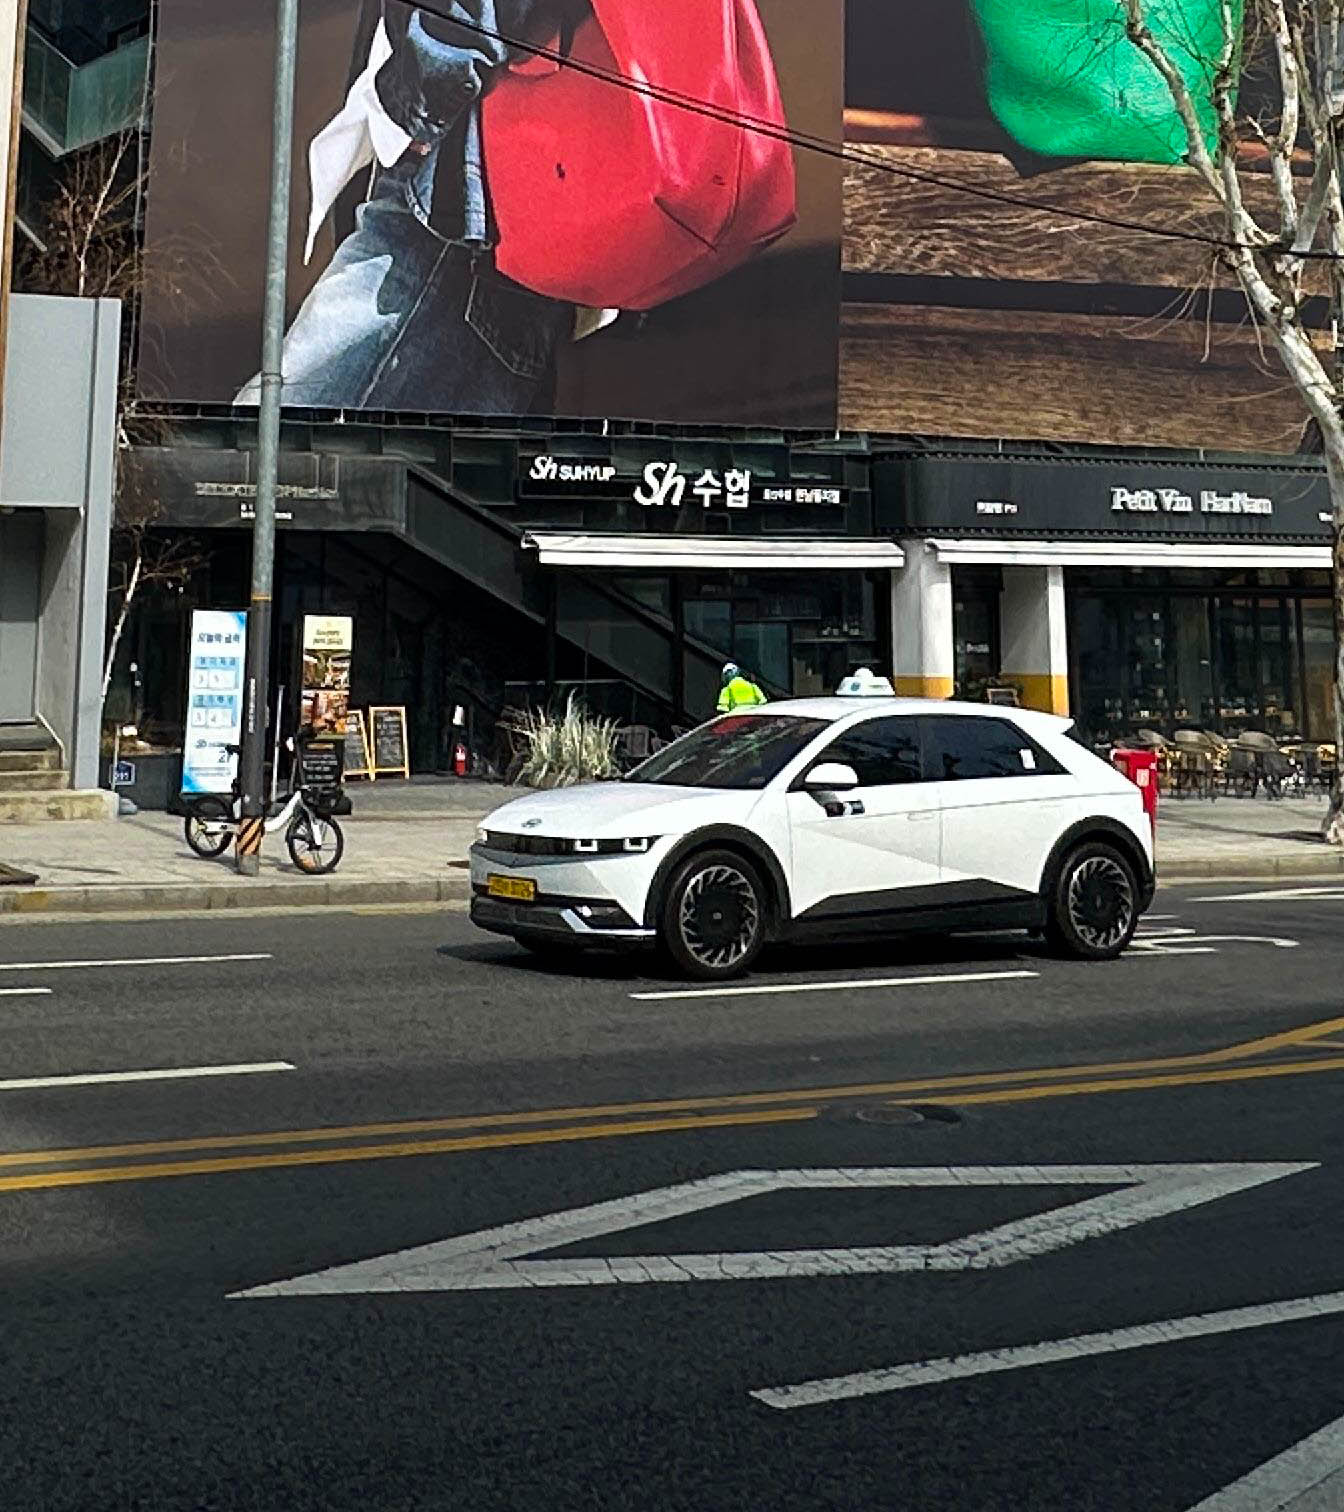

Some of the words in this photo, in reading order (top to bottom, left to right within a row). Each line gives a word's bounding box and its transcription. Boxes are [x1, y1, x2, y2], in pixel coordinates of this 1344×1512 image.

[559, 464, 616, 481] SUHYUP
[633, 462, 687, 506] Sh
[692, 468, 752, 508] 수협
